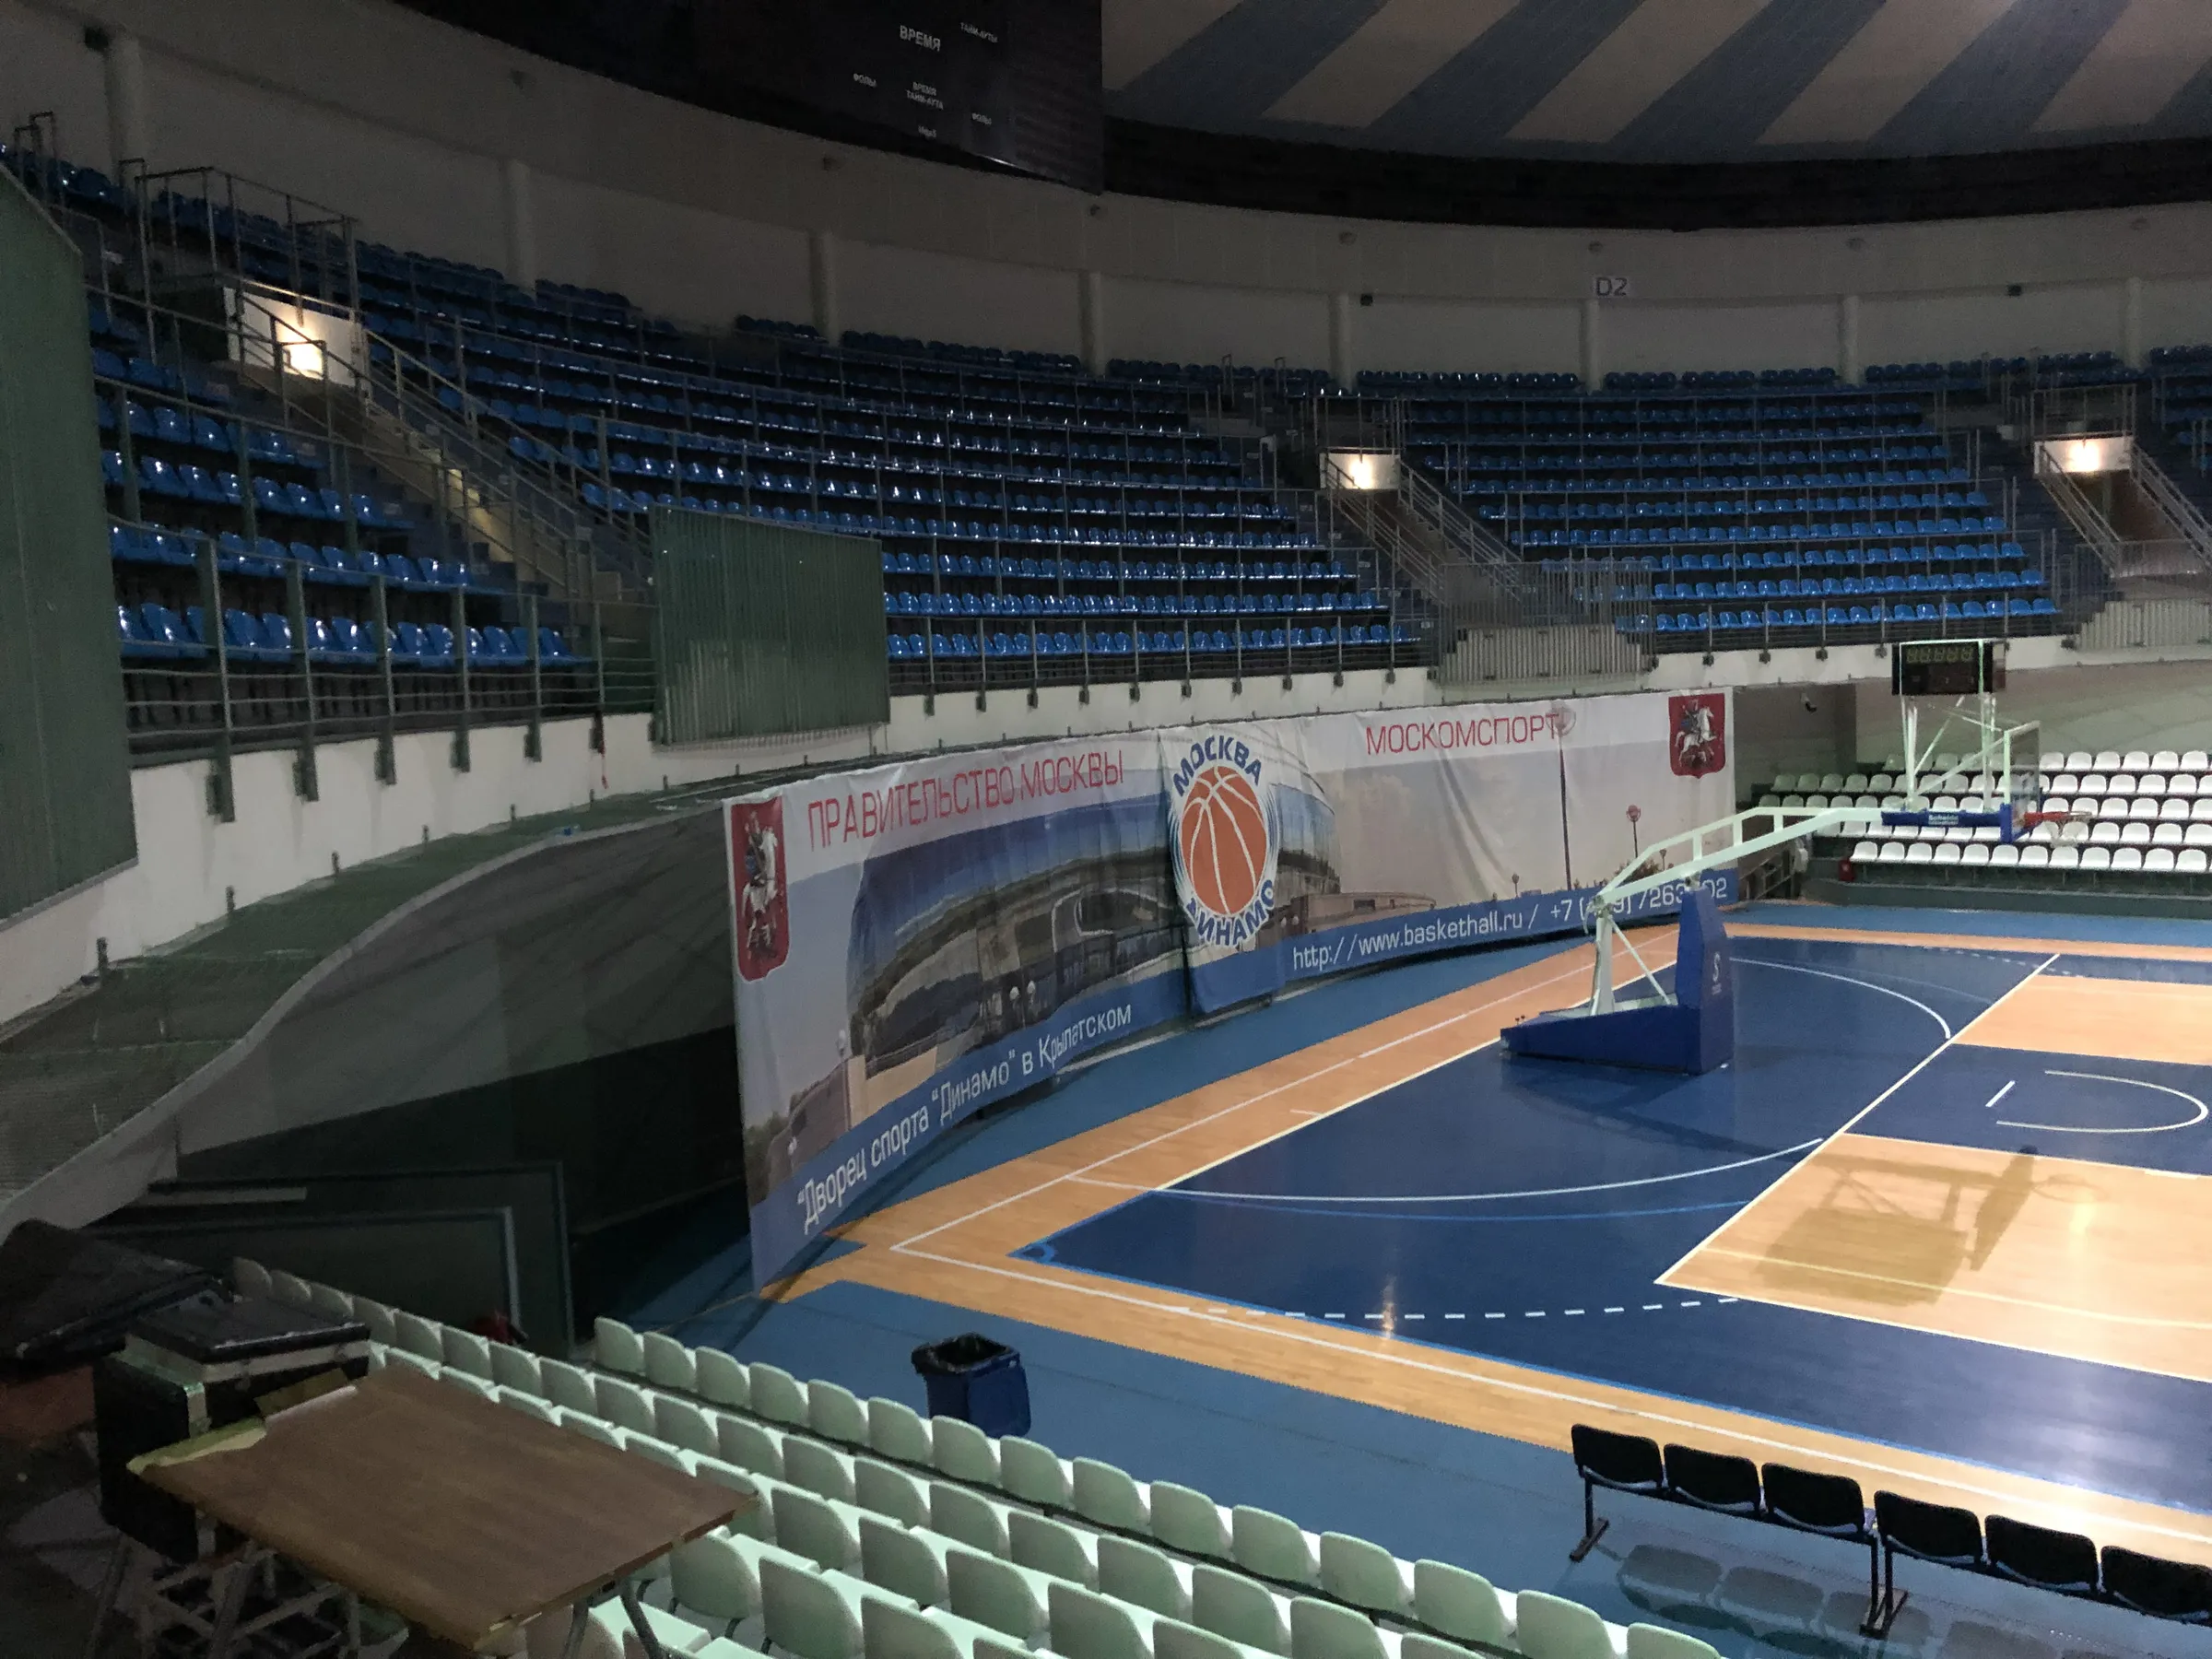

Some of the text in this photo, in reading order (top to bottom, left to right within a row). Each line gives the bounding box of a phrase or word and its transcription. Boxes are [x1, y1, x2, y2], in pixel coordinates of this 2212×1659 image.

[900, 24, 941, 52] ВРЕМЯ
[1596, 277, 1628, 296] D2
[1366, 712, 1559, 755] МОСКОМСПОРТ
[1172, 735, 1263, 796] МОСКВА
[806, 749, 1124, 852] ПРАВИТЕЛЬСТВО МОСКВЫ
[870, 1106, 929, 1172] спорта
[1021, 1052, 1033, 1076] в
[1039, 1004, 1132, 1069] Крылатском
